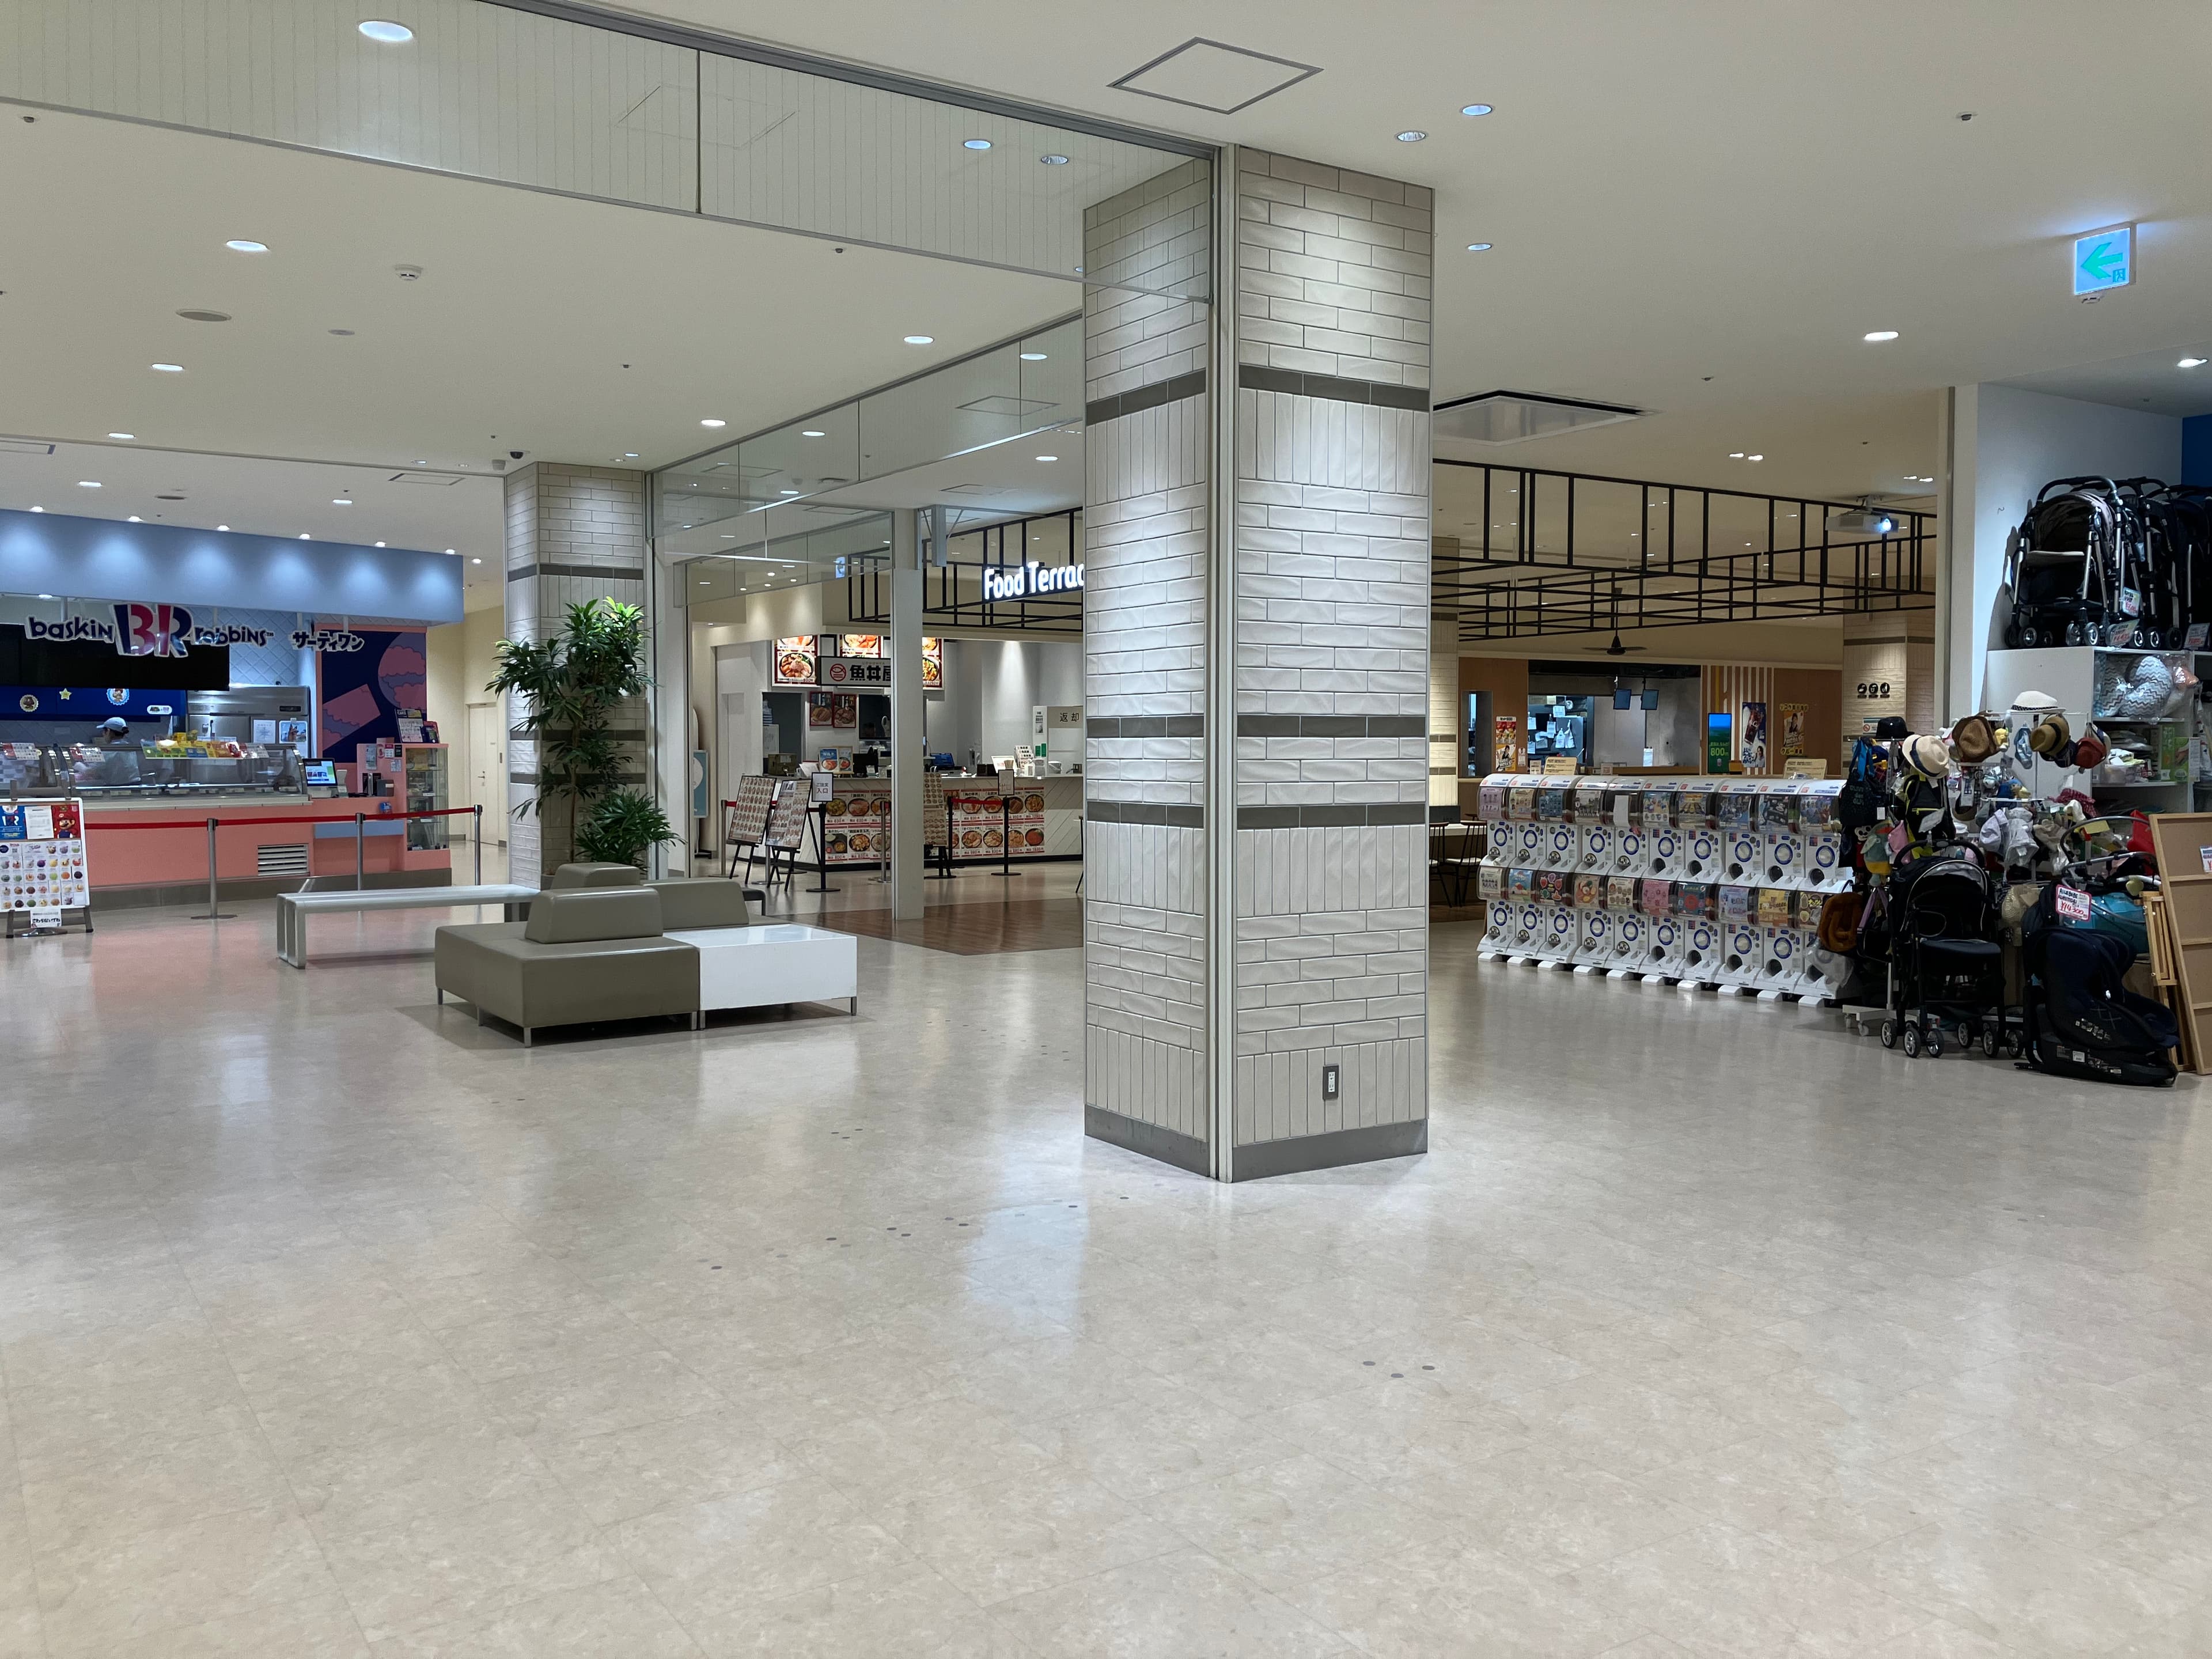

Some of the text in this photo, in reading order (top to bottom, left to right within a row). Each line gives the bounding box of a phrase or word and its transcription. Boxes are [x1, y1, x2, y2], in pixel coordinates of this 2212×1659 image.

[984, 566, 1025, 600] Food
[113, 604, 192, 656] BR
[293, 632, 363, 650] サーティワン
[1059, 712, 1080, 722] 返却
